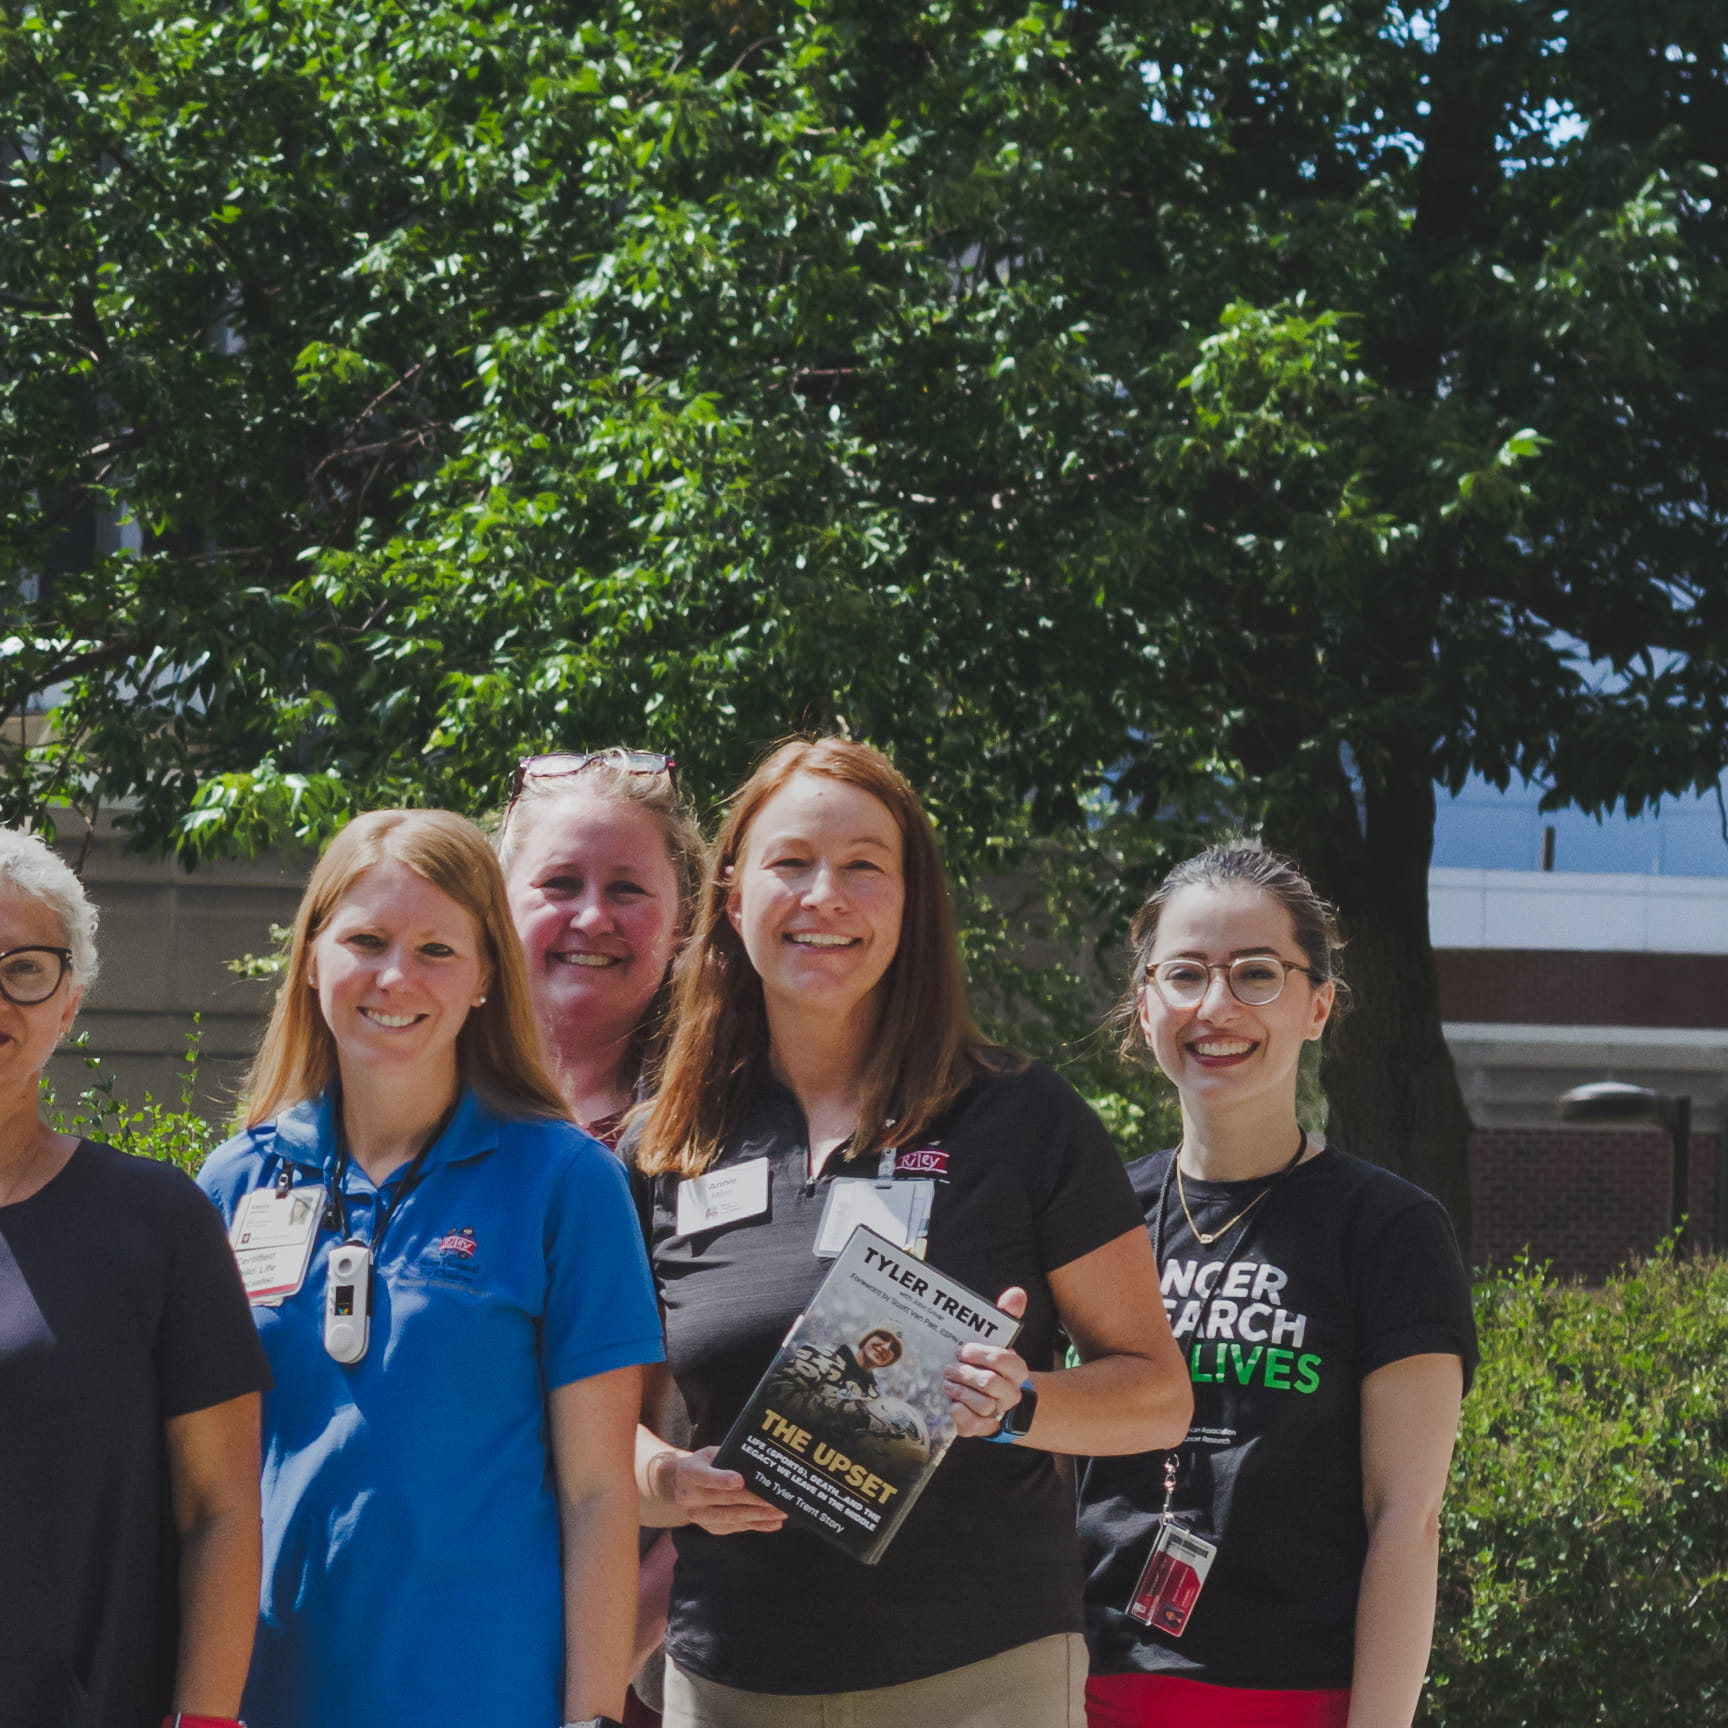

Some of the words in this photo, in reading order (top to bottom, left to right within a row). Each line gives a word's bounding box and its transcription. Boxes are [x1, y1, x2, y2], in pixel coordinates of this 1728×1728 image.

[900, 1152, 941, 1169] Riley
[864, 1247, 929, 1297] TYLER
[932, 1289, 999, 1338] TRENT
[1160, 1258, 1289, 1306] NCER
[1191, 1342, 1322, 1394] LIVES
[741, 1442, 777, 1468] LEGACY
[777, 1464, 792, 1478] WE
[790, 1474, 818, 1495] LEAVE
[761, 1408, 812, 1453] THE
[812, 1442, 898, 1504] UPSET
[755, 1470, 772, 1487] The
[773, 1481, 795, 1501] Tyler
[795, 1493, 819, 1517] Trent
[818, 1512, 845, 1534] Story
